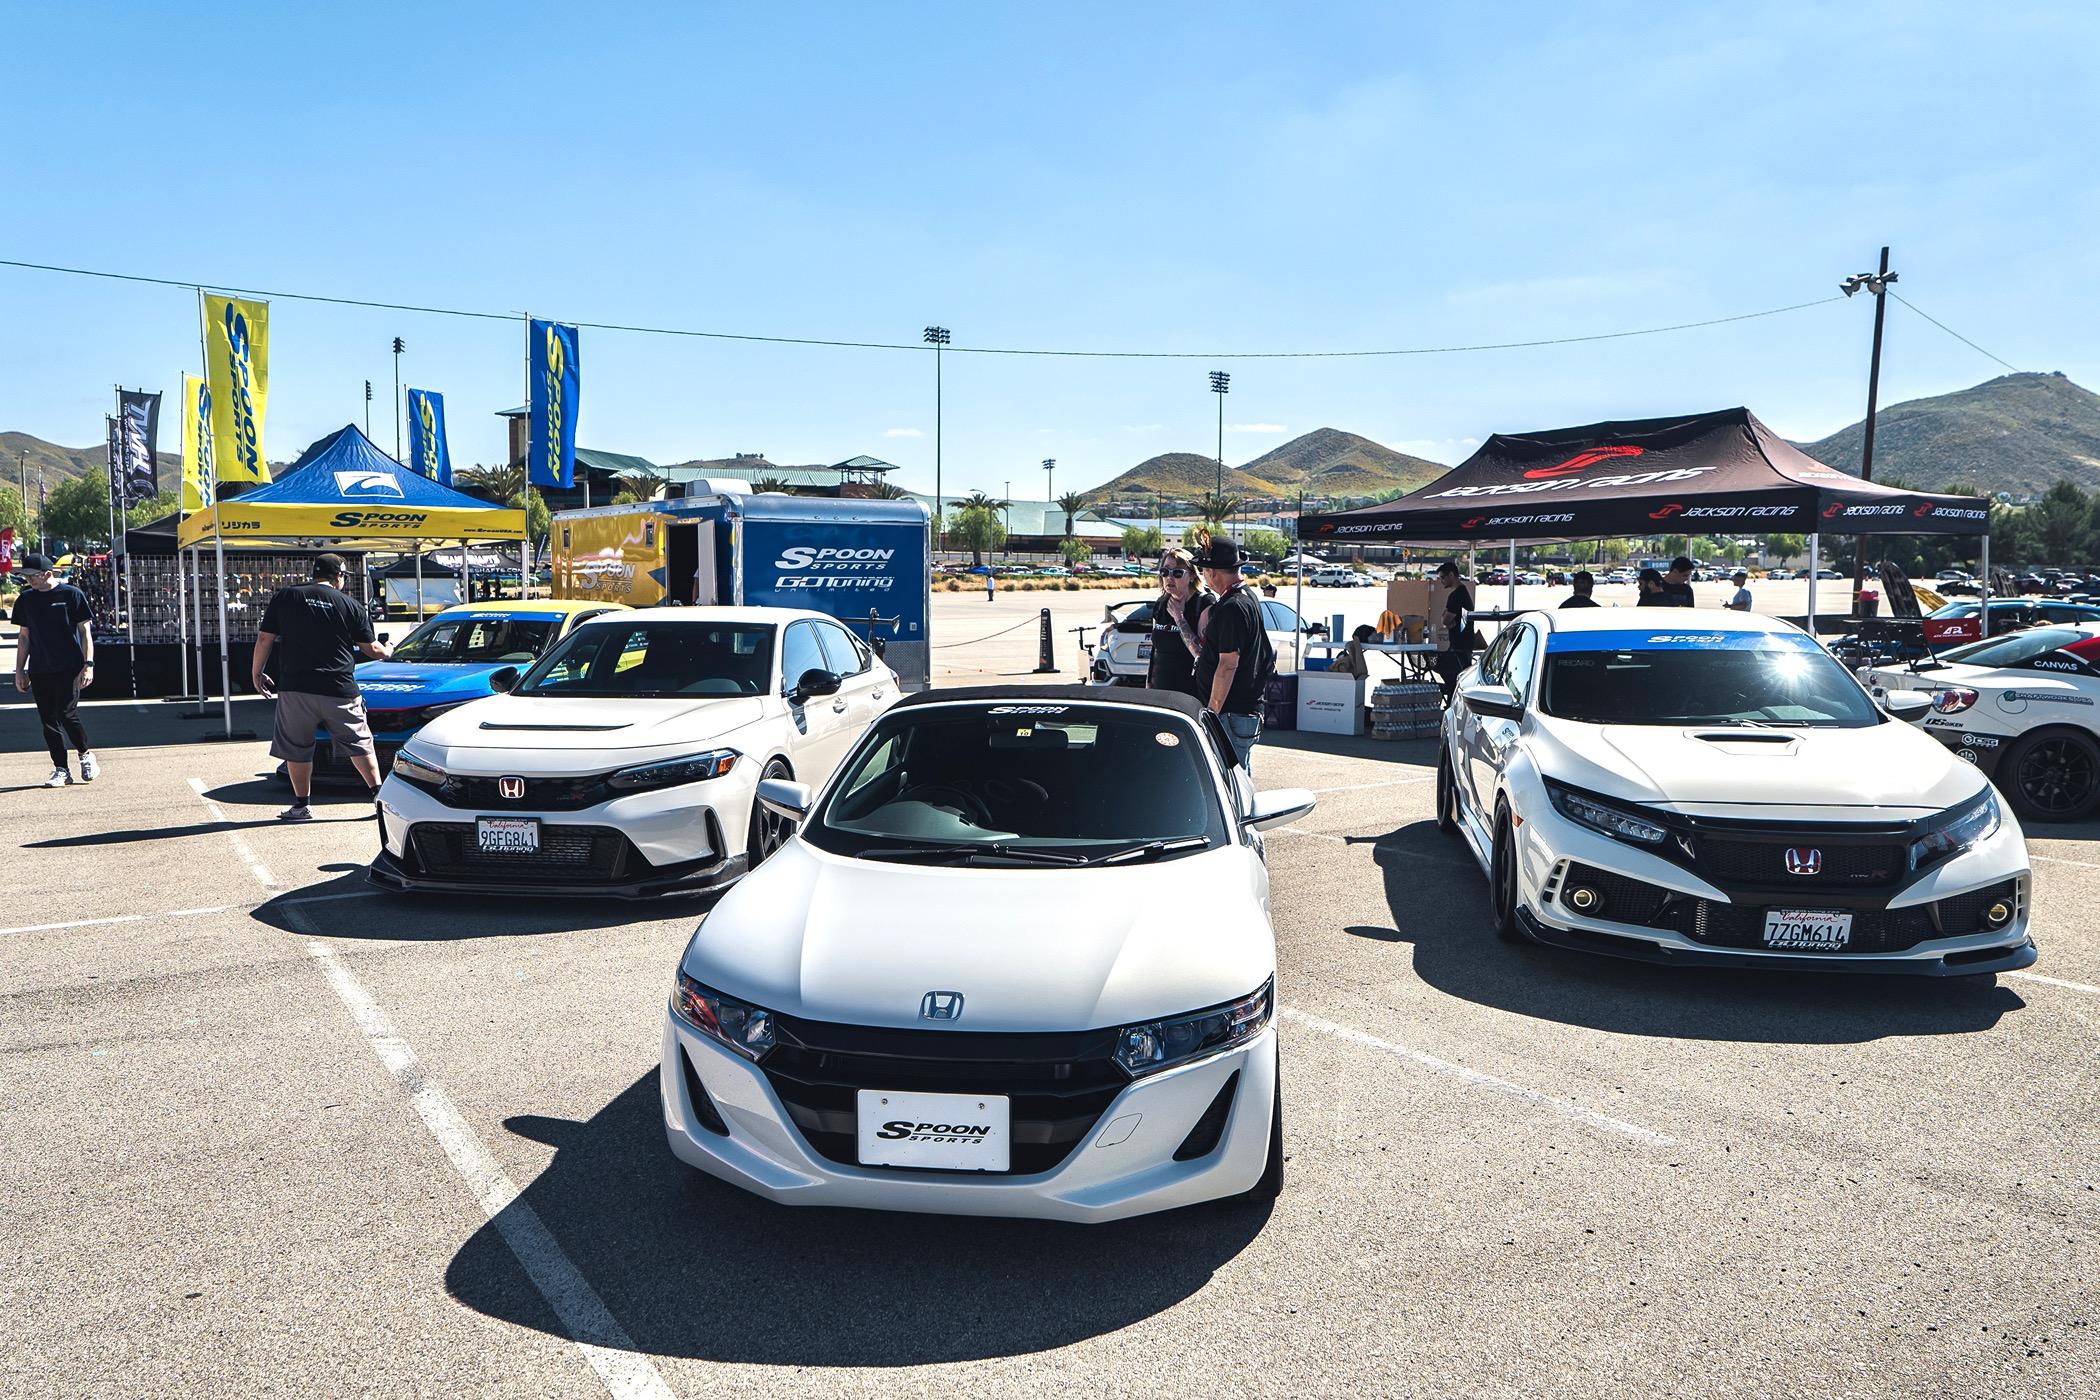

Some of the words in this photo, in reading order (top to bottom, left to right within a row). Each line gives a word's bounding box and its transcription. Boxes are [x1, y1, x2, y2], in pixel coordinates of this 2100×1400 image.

[226, 302, 259, 477] SPOON
[229, 351, 243, 462] SPORTS
[546, 326, 564, 482] SPOON
[222, 521, 260, 529] リジカラ
[330, 512, 427, 527] SPOON
[775, 547, 895, 569] SPOON
[581, 561, 635, 589] SPOON
[594, 582, 632, 593] SPORTS
[2034, 660, 2078, 670] CANVAS
[987, 706, 1069, 714] SPOON
[1782, 912, 1839, 924] California
[1768, 922, 1845, 942] 7ZGM614
[876, 1121, 991, 1139] SPOON
[908, 1135, 982, 1144] SPORTS
